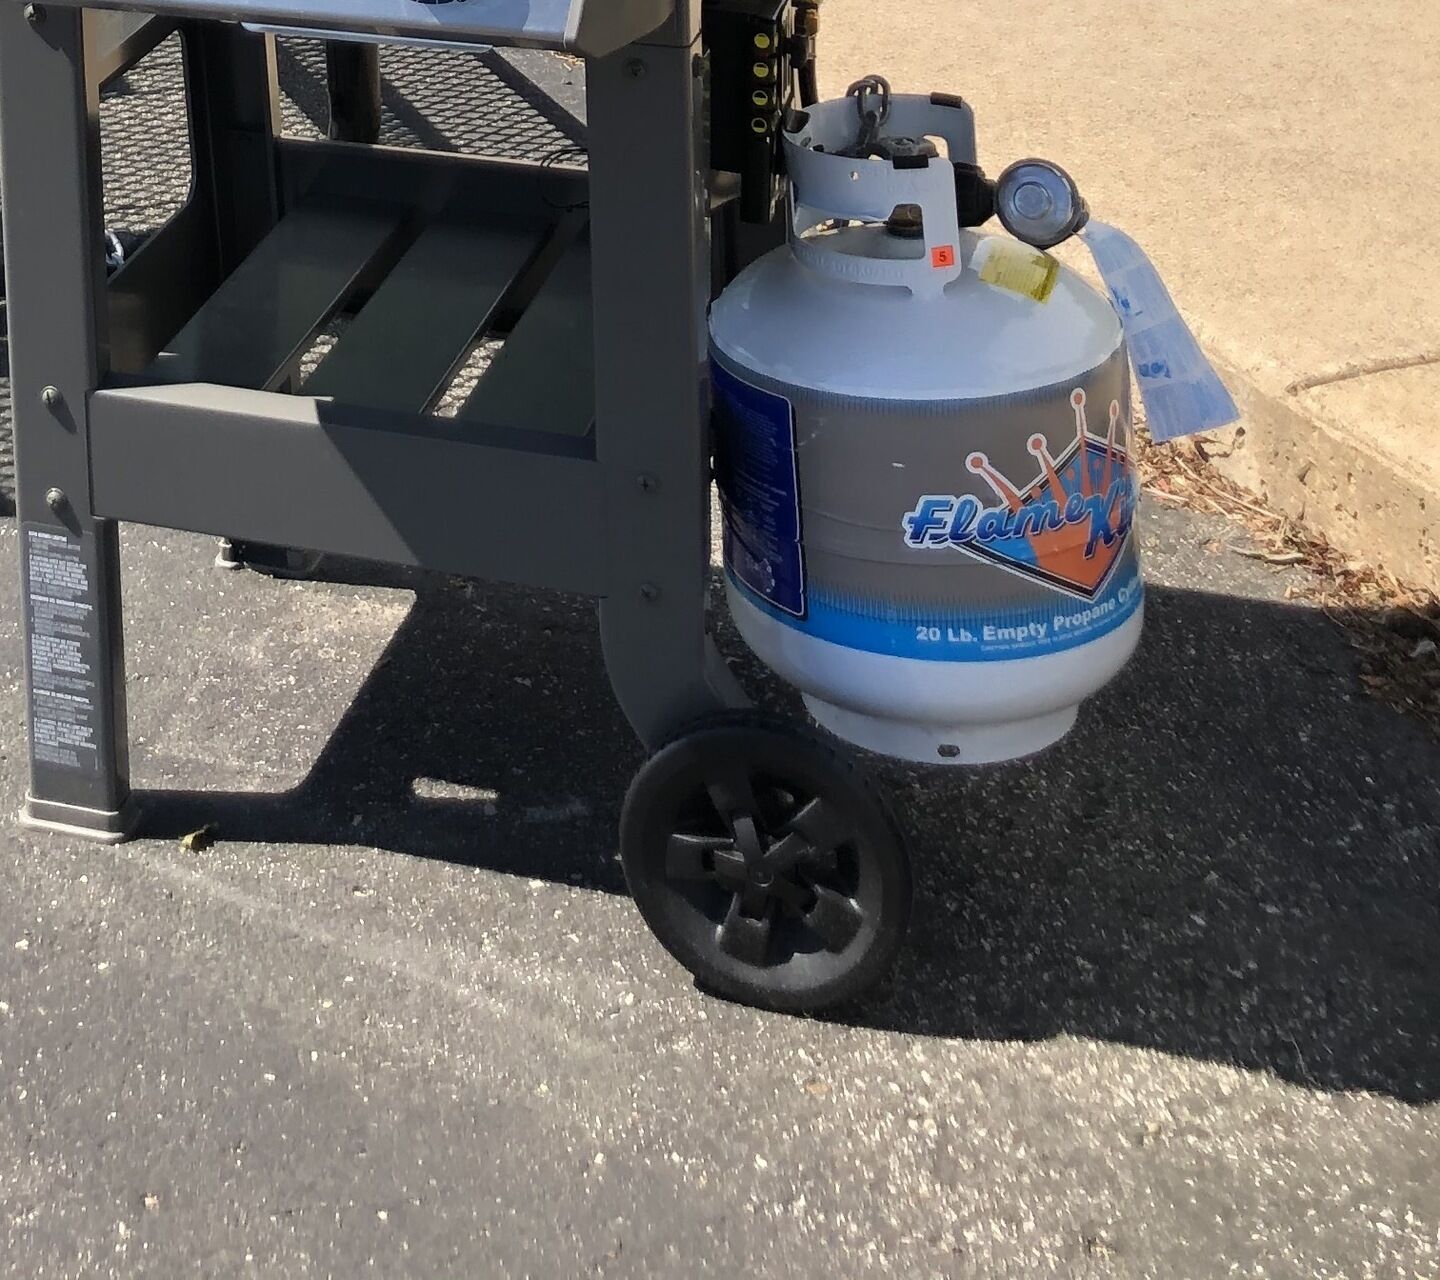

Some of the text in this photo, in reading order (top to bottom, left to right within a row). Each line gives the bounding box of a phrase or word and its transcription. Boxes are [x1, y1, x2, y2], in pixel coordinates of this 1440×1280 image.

[938, 250, 948, 264] 5
[915, 625, 941, 641] 20
[947, 627, 978, 642] Lb.
[982, 622, 1048, 643] Empty
[1053, 597, 1116, 631] Propane
